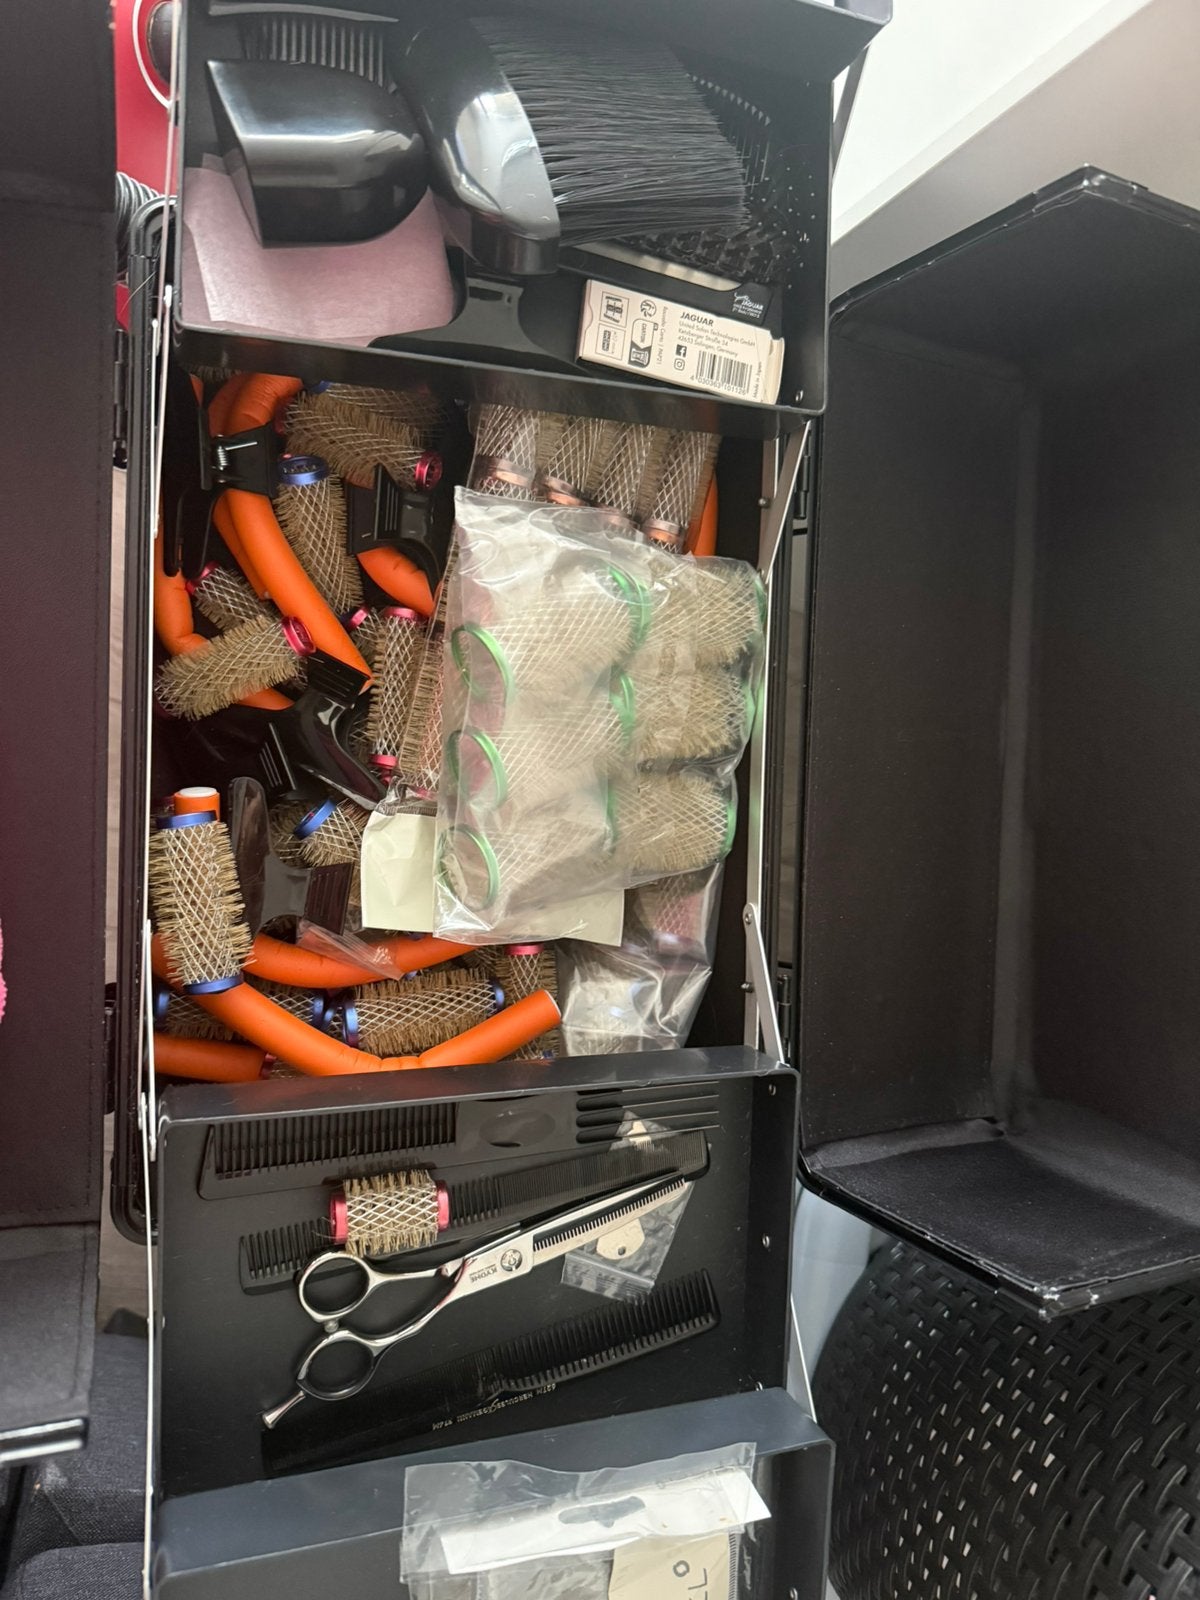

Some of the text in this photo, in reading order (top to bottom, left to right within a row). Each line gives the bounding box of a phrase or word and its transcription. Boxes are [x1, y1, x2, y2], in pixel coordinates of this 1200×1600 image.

[741, 300, 764, 310] JAGUAR
[680, 311, 714, 327] JAGUAR
[679, 320, 695, 330] United
[710, 328, 739, 342] Technologies
[740, 337, 756, 347] GmbH
[716, 345, 738, 357] Germany
[497, 1392, 534, 1409] HERCULES
